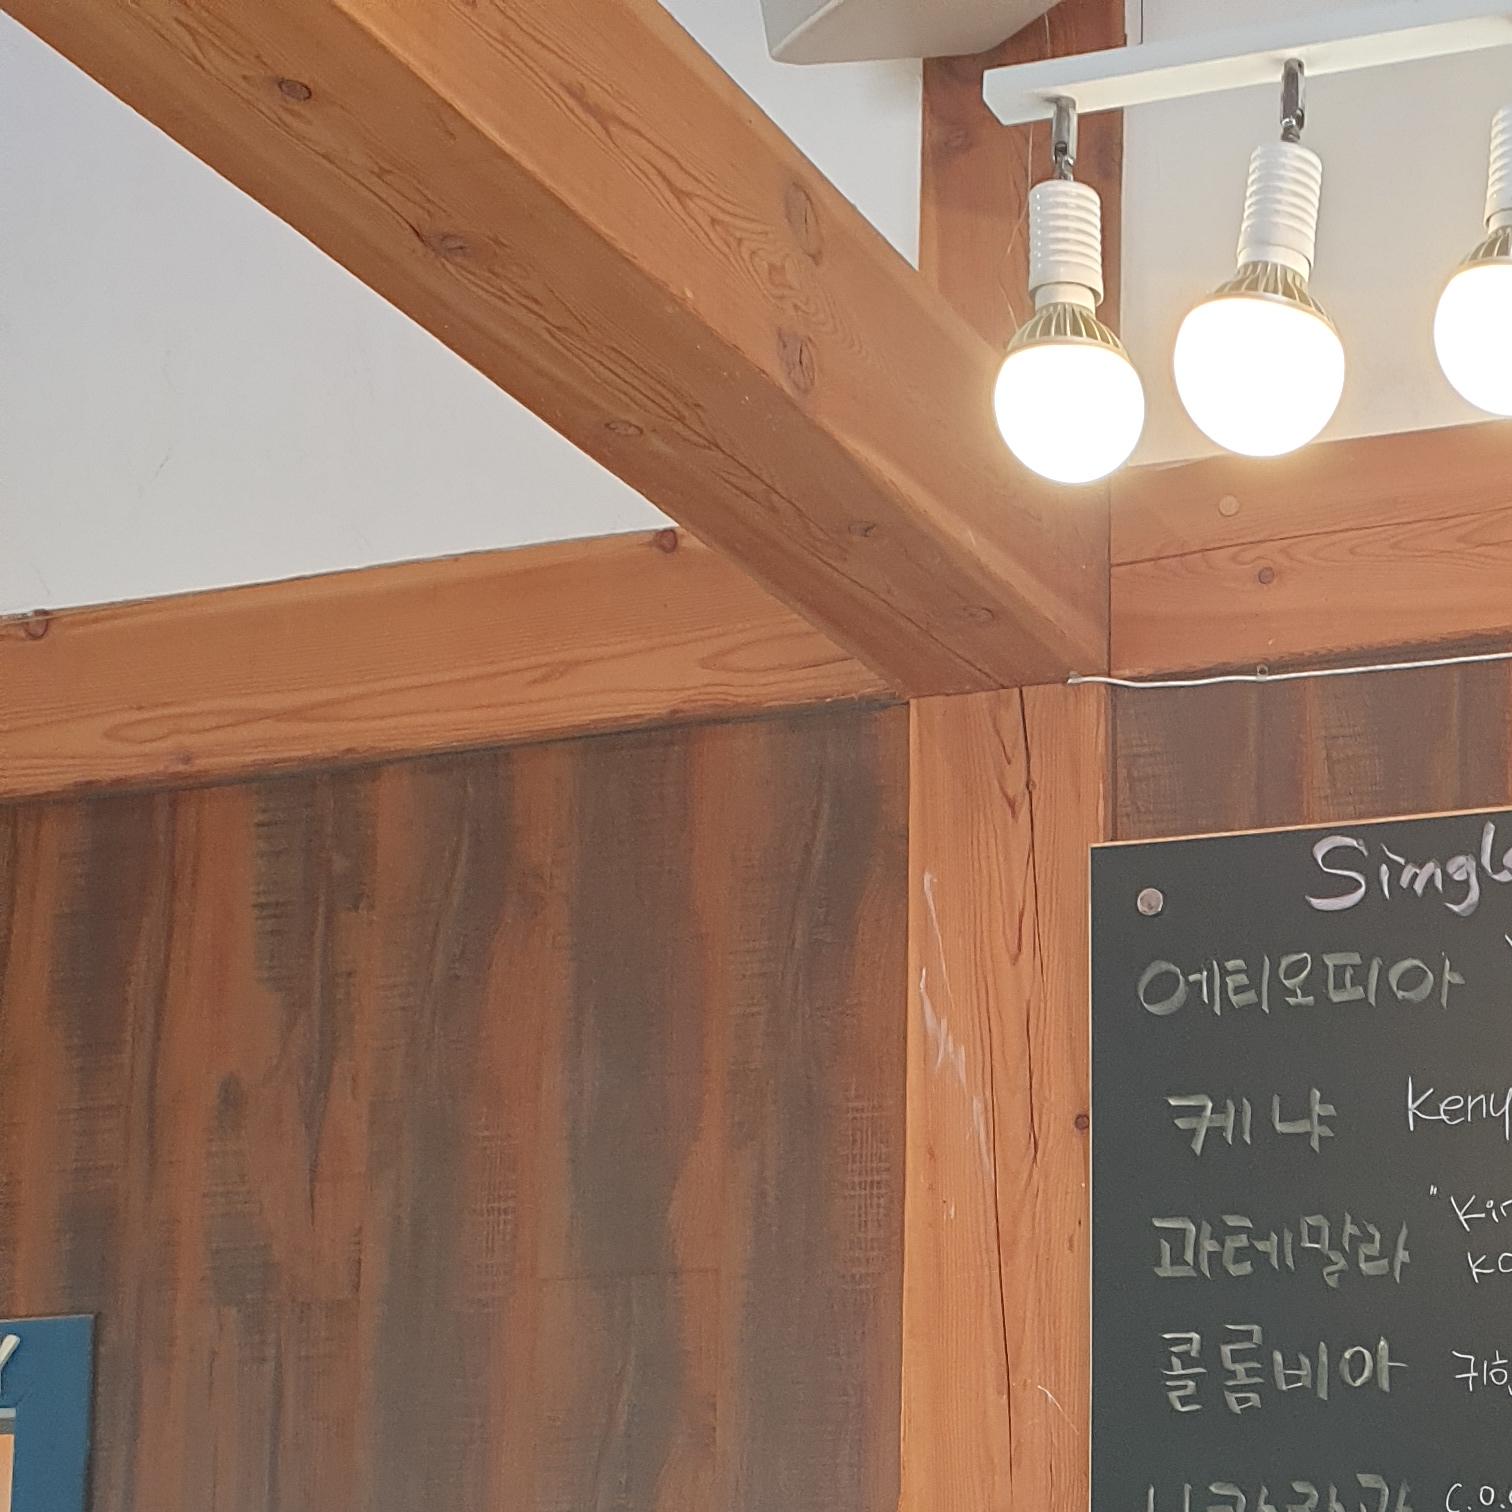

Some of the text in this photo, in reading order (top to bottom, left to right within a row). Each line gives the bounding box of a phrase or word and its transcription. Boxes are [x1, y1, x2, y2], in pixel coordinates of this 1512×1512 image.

[1138, 952, 1465, 1015] 에티오피아
[1164, 1088, 1337, 1156] 케냐
[1152, 1211, 1410, 1288] 과테말라
[1160, 1324, 1408, 1415] 콜롬비아
